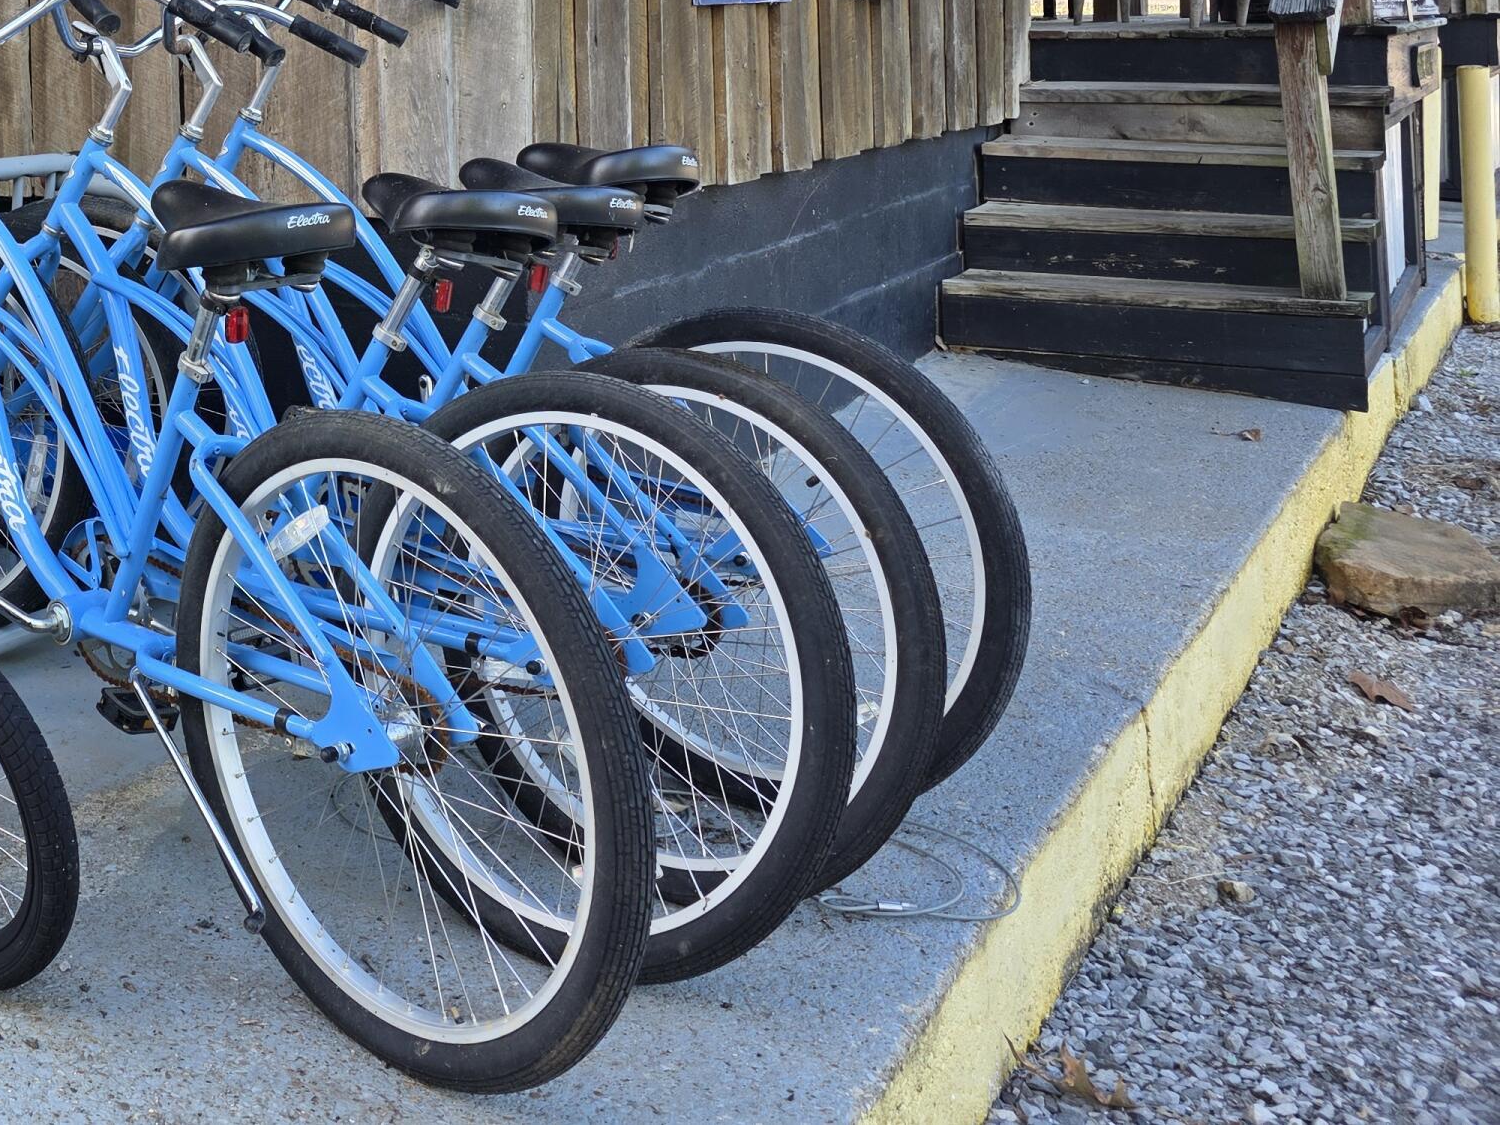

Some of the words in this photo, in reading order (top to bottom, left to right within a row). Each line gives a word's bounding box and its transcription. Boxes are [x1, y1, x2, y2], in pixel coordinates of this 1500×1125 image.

[609, 197, 637, 210] Electra
[517, 204, 548, 219] Electra
[286, 211, 331, 229] Electra
